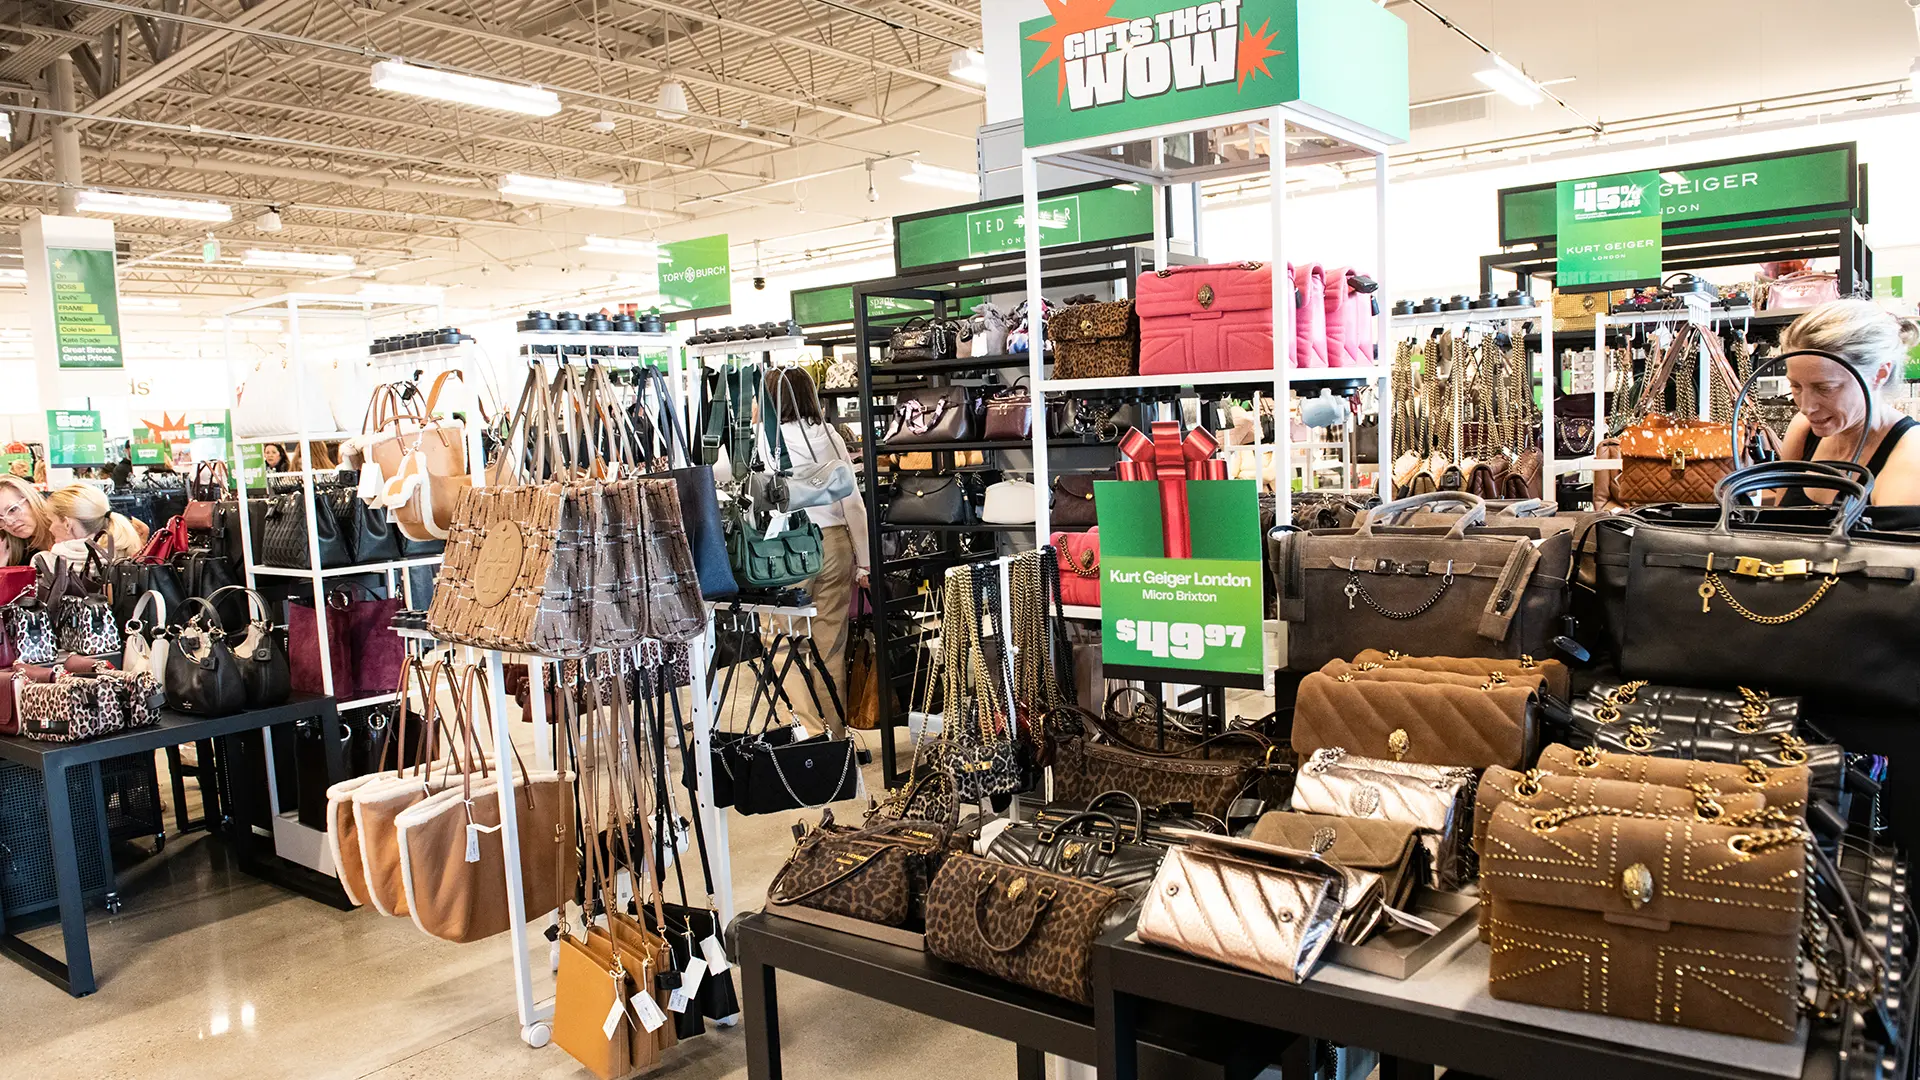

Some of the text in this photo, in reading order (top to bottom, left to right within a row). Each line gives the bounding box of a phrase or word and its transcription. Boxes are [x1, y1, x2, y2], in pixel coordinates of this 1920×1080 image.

[1063, 16, 1155, 61] GIFTS
[1065, 26, 1238, 111] WOW
[1658, 172, 1758, 197] GEIGER
[975, 218, 1004, 235] TED
[1002, 233, 1045, 246] LONN
[1566, 239, 1655, 255] KURT GEIGER
[663, 265, 726, 283] TORY BURCH
[60, 315, 94, 323] Madewell
[79, 337, 101, 345] Spade
[61, 346, 117, 354] Great Brands.
[87, 354, 114, 362] Prices.
[1109, 569, 1251, 587] Kurt Geiger London
[1142, 589, 1217, 603] Micro Brixton
